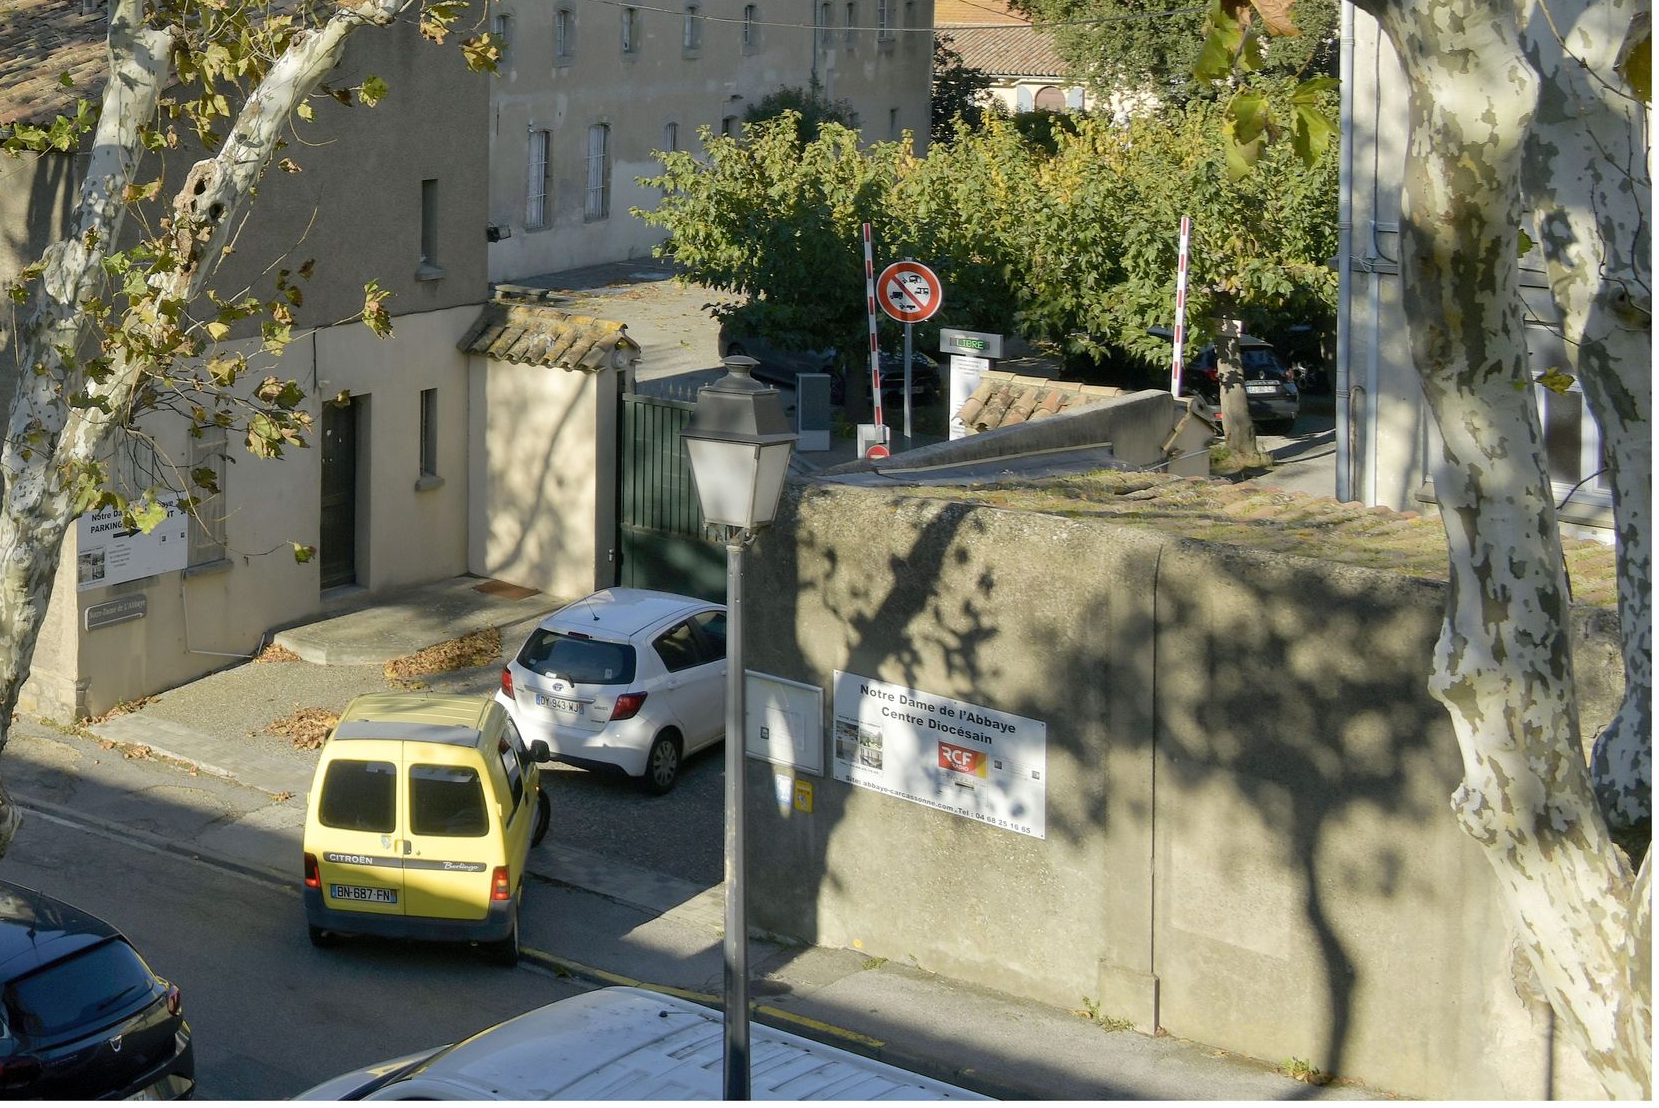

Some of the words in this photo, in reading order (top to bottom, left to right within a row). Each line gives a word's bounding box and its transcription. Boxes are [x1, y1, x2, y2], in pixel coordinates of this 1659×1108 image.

[956, 338, 984, 350] LIBRE
[91, 512, 112, 522] Notre
[90, 520, 123, 534] PARKING
[860, 683, 895, 702] Notre
[899, 694, 935, 712] Dame
[939, 705, 955, 718] de
[959, 710, 1016, 734] l'Abbaye
[881, 706, 924, 726] Centre
[928, 718, 992, 745] Diocésain
[941, 746, 972, 766] RCF
[863, 781, 954, 812] abbaye-carcassonne.com
[975, 812, 985, 821] 04
[987, 815, 996, 824] 68
[998, 819, 1008, 827] 25
[329, 853, 373, 864] CITROËN
[442, 861, 479, 872] Berlingo
